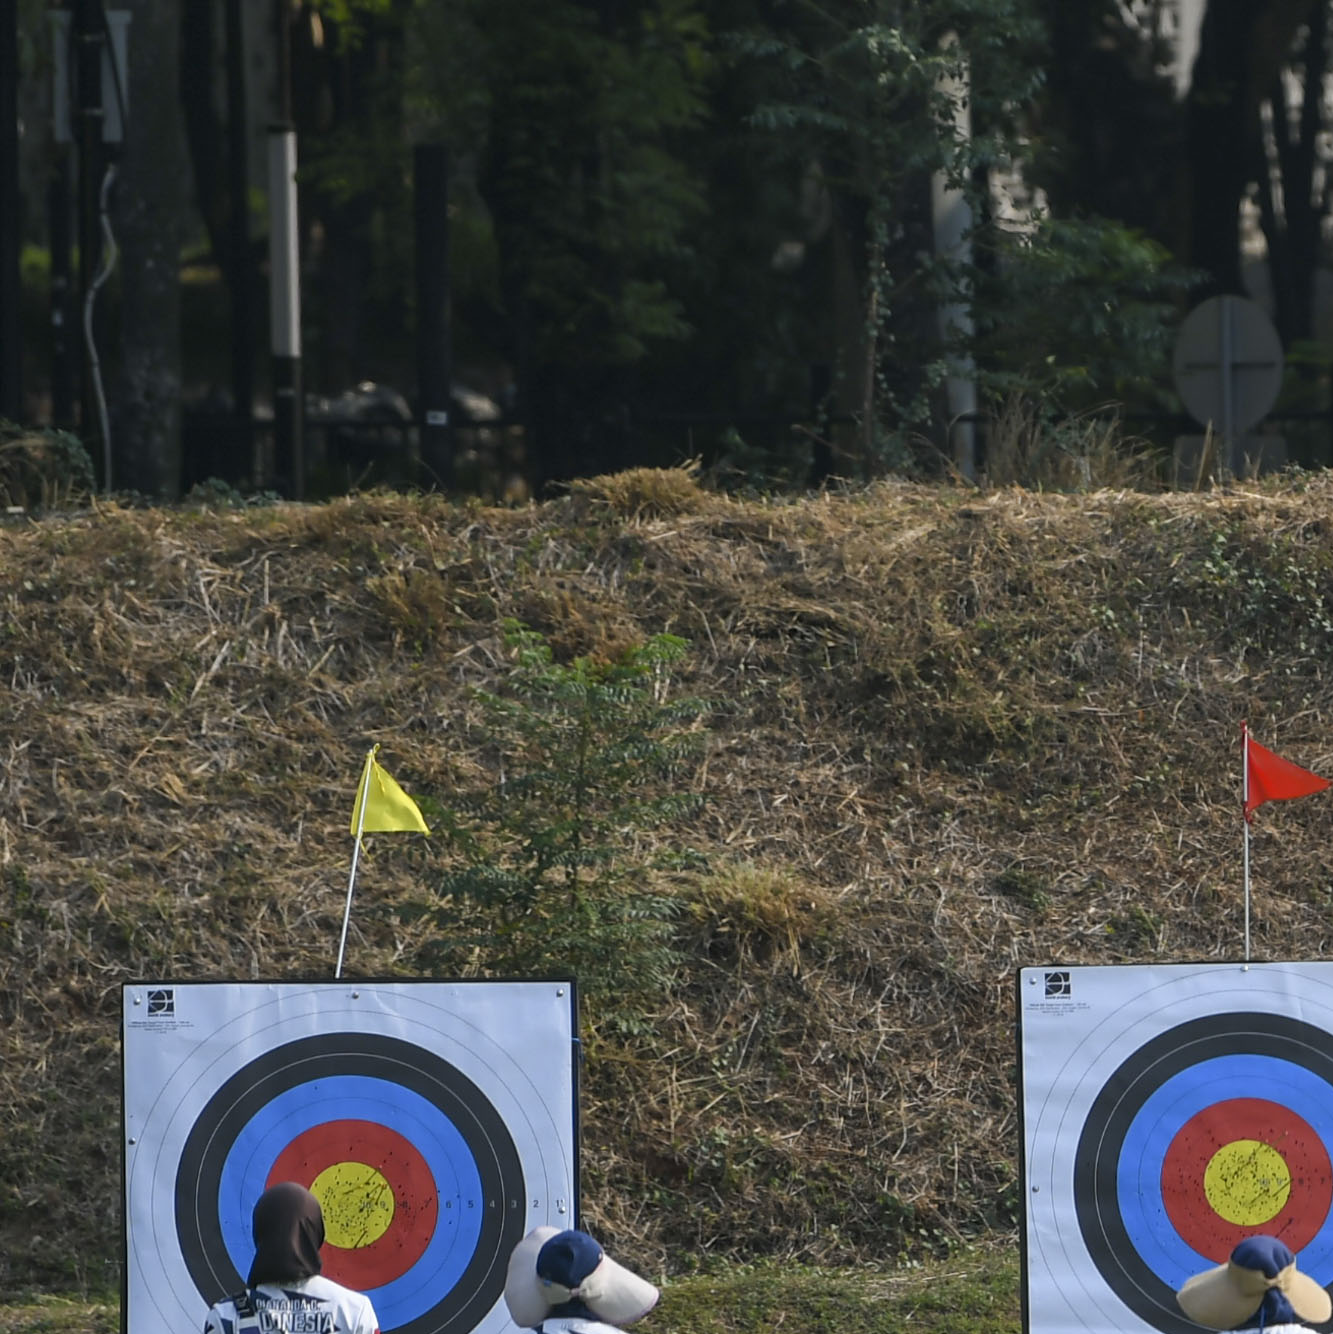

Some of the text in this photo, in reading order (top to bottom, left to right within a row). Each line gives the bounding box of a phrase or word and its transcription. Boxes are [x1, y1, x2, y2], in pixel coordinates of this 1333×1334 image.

[468, 1200, 474, 1208] 5
[489, 1200, 496, 1208] 4
[511, 1200, 518, 1208] 3
[533, 1200, 540, 1208] 2
[261, 1312, 335, 1334] DONESIA
